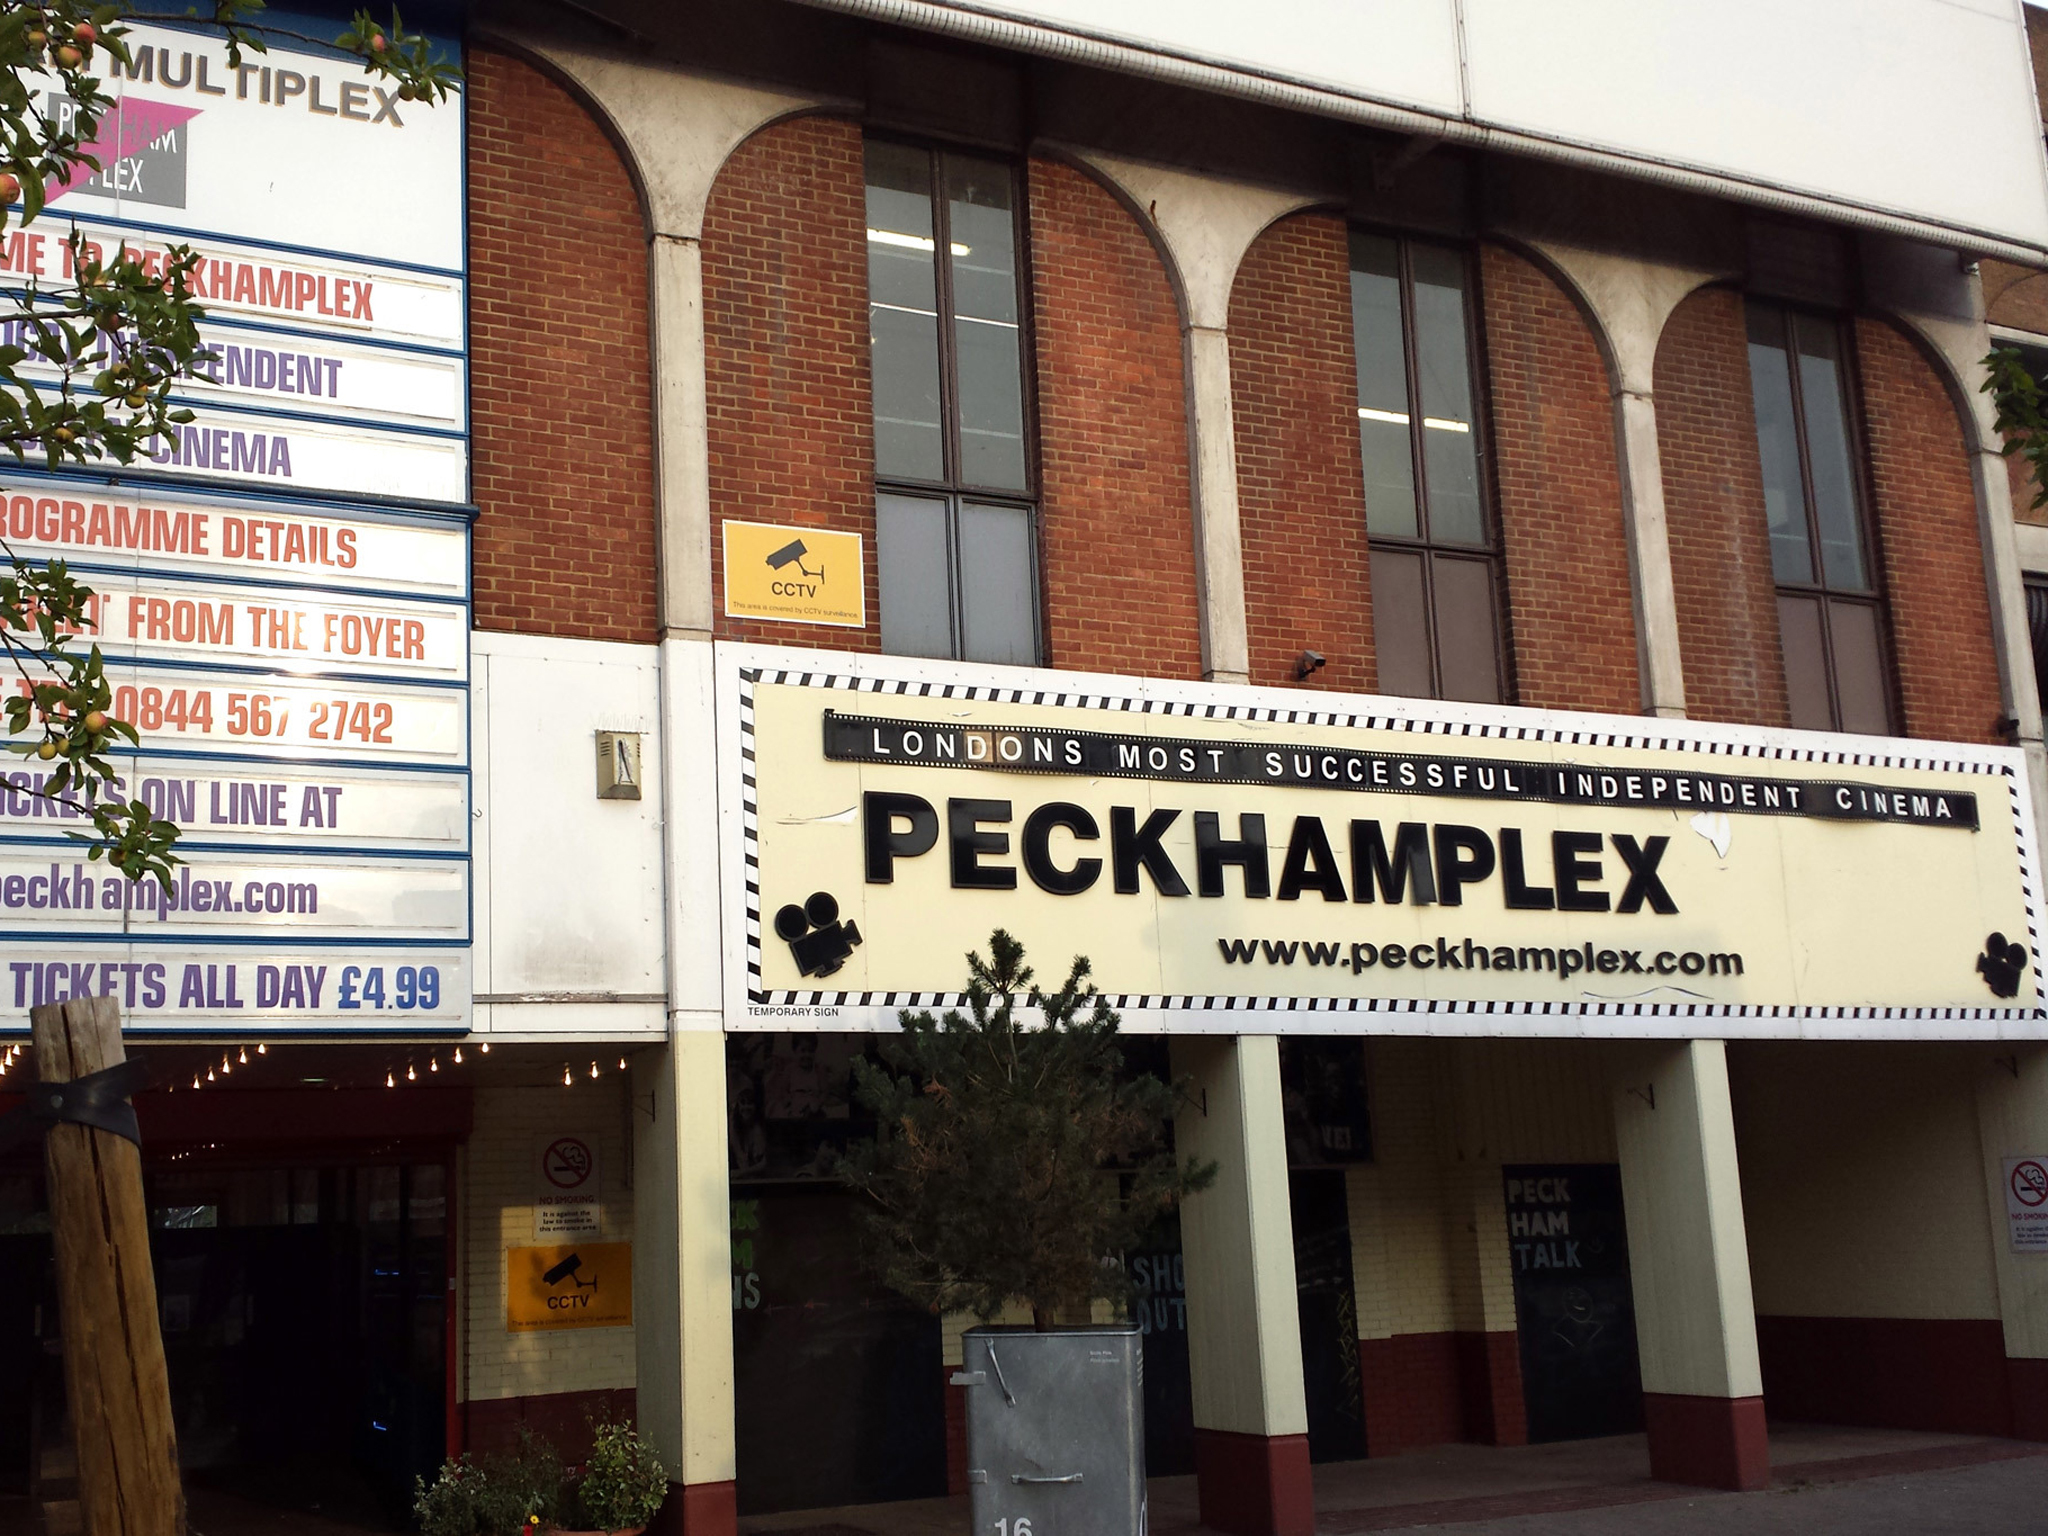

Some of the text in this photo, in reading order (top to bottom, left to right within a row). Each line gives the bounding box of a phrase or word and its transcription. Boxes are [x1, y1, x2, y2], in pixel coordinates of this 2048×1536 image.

[110, 41, 405, 127] MULTIPLEX
[59, 102, 177, 153] PKHAM
[89, 156, 143, 193] LEX
[97, 329, 342, 398] INENDENT
[148, 424, 292, 477] CINEMA
[222, 517, 357, 569] DETAILS
[733, 601, 746, 609] This
[769, 605, 794, 613] covered
[795, 606, 802, 615] by
[803, 607, 822, 615] CCTV
[771, 581, 817, 598] CCTV
[128, 596, 233, 645] FROM
[248, 607, 308, 650] THE
[324, 614, 425, 660] FOYER
[115, 686, 213, 733] 0844
[227, 694, 288, 737] 567
[309, 701, 393, 744] 2742
[872, 727, 1952, 818] LONDONS MOST SUCCESSFUL INDEPENDENT CINEMA
[141, 778, 195, 823] ON
[210, 781, 287, 827] LINE
[300, 786, 342, 828] AT
[862, 790, 1680, 915] PECKHAMPLEX
[0, 863, 318, 921] eckhamplex.com
[1218, 936, 1744, 981] www.peckhamplex.com
[9, 962, 440, 1010] TICKETS ALL DAY £4.99
[748, 1007, 839, 1017] TEMPORARY SIGN
[539, 1195, 594, 1205] NO SMOKING
[1507, 1177, 1571, 1203] PECK
[1510, 1210, 1570, 1237] HAM
[1514, 1240, 1582, 1270] TALK
[547, 1294, 590, 1310] CCTV
